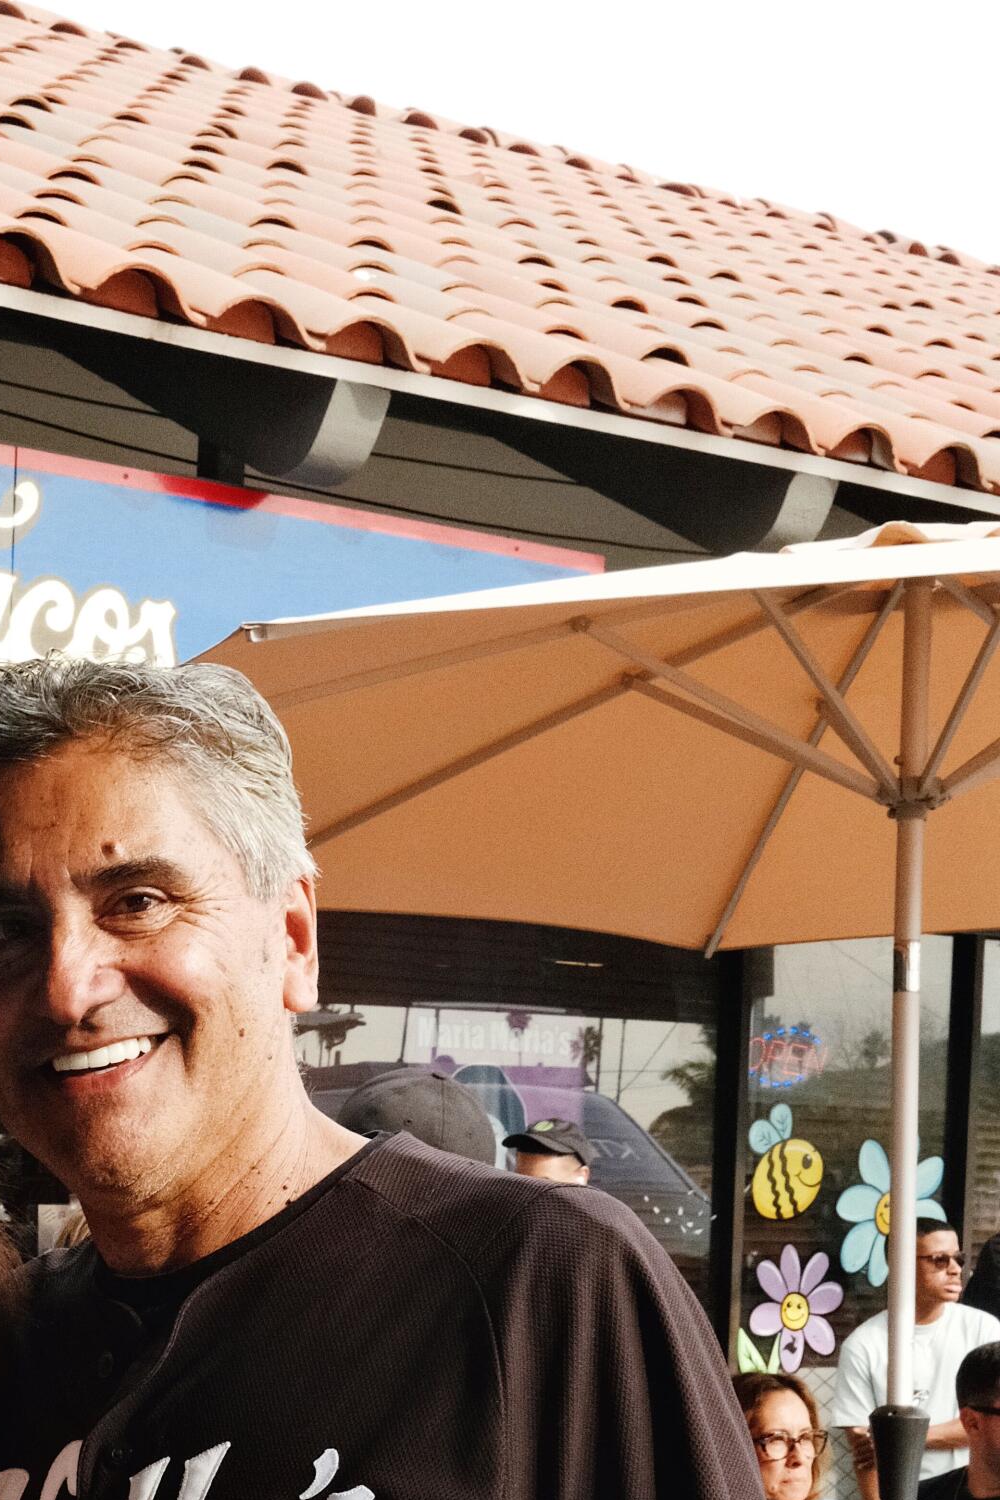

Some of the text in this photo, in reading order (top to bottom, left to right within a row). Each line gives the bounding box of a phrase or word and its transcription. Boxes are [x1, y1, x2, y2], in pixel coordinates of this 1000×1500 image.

[418, 1016, 571, 1055] Maria Maria's
[748, 1035, 829, 1077] OPEN
